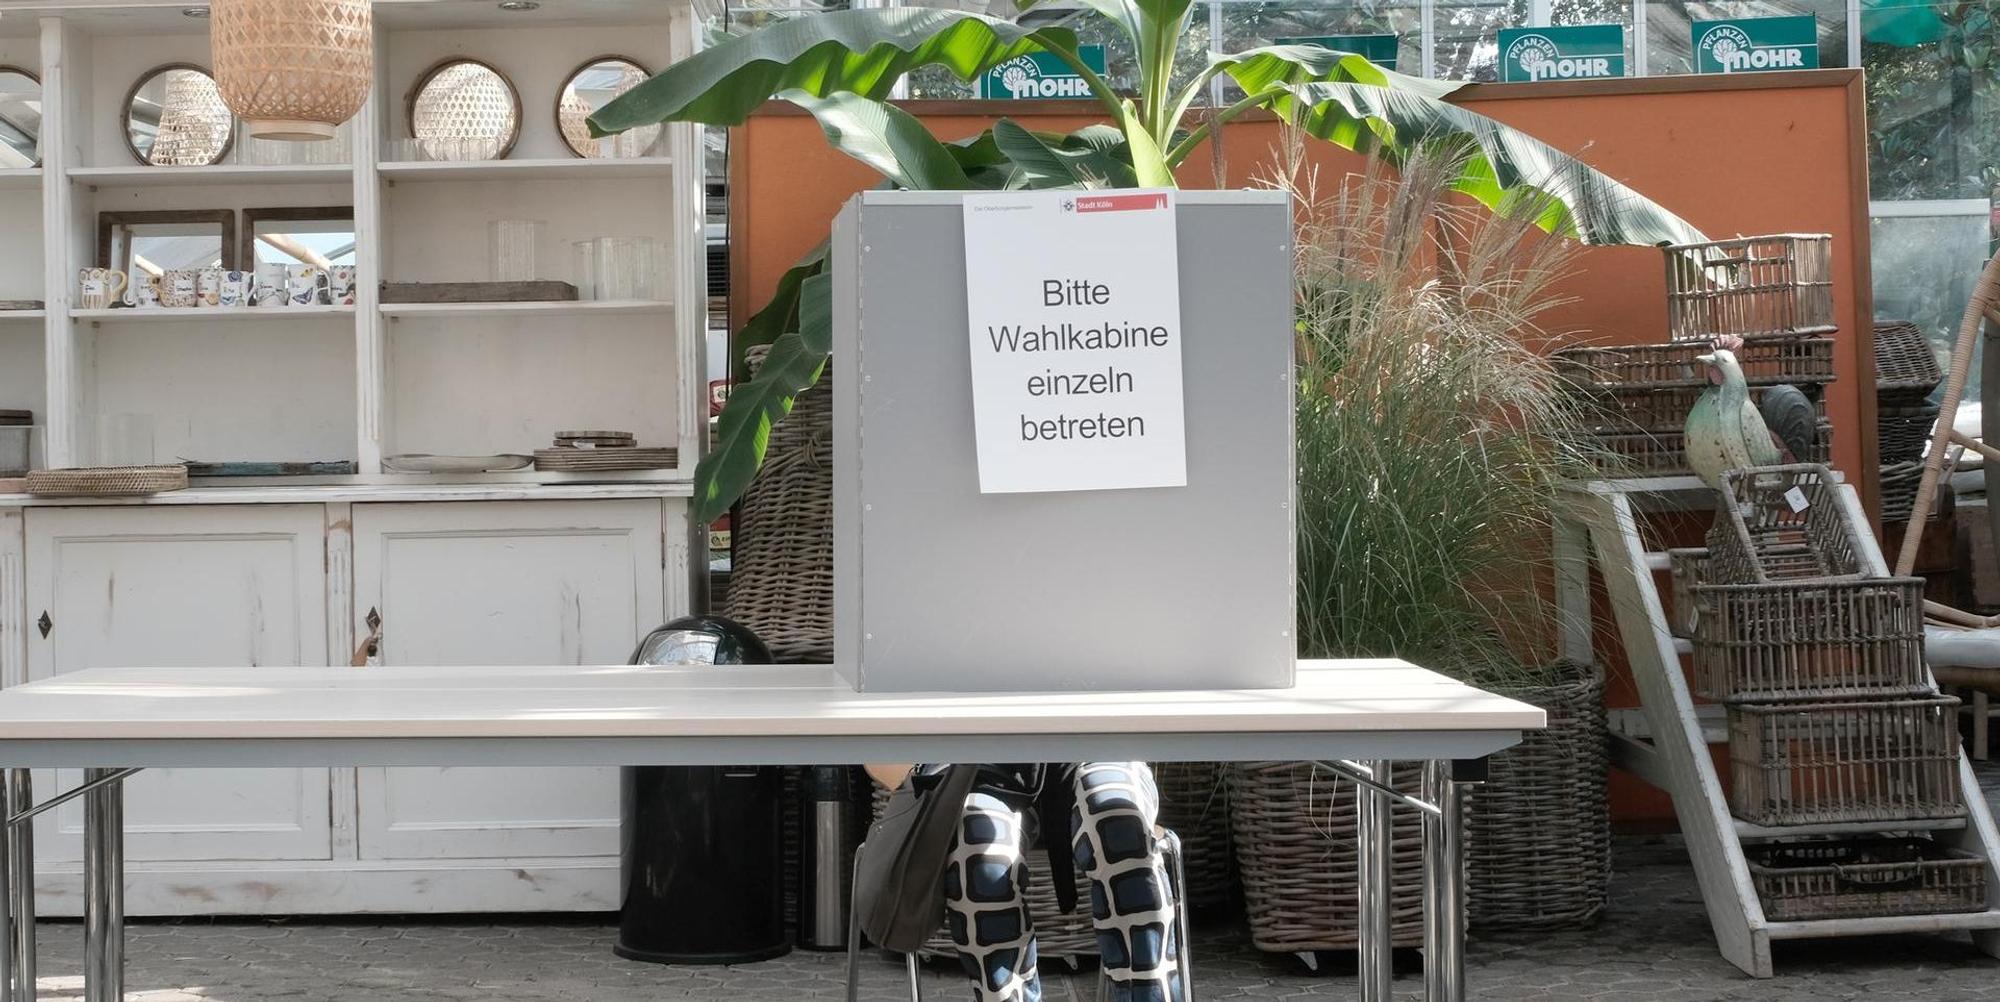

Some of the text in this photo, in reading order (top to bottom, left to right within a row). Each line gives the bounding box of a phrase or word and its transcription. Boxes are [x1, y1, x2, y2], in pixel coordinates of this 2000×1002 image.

[1509, 37, 1555, 59] PFLANZEN
[1703, 28, 1748, 50] PFLANZEN
[992, 56, 1037, 78] PFLANZEN
[1077, 200, 1113, 210] Stadt Köln
[1042, 279, 1110, 307] Bitte
[988, 321, 1169, 353] Wahlkabine
[1027, 366, 1133, 396] einzeln
[1021, 412, 1145, 441] betreten
